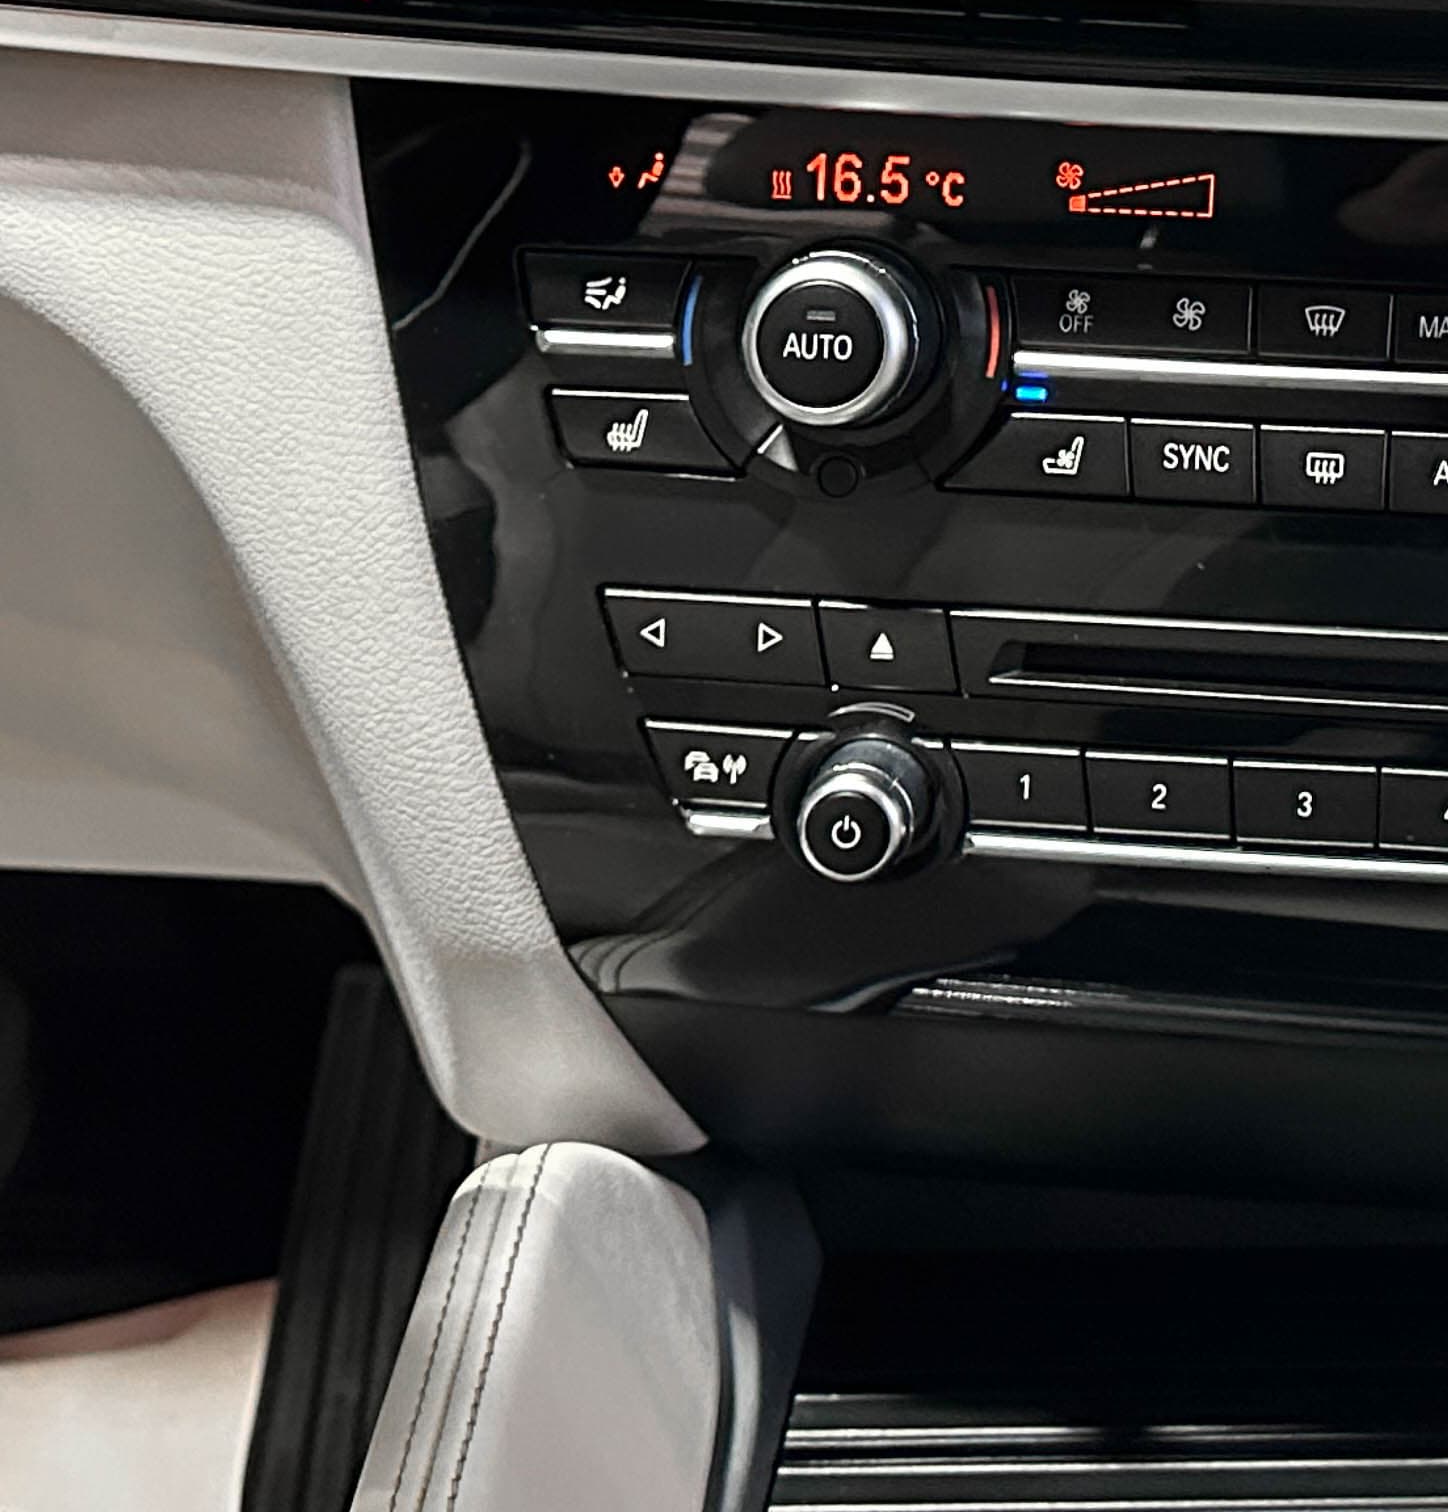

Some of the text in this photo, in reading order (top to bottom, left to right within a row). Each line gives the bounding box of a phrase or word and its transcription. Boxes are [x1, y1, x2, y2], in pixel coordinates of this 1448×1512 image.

[806, 152, 911, 204] 16.5
[1059, 315, 1093, 334] OFF
[782, 332, 853, 361] AUTO
[1163, 442, 1230, 473] SYNC
[1019, 774, 1030, 800] 1
[1151, 783, 1167, 810] 2
[1296, 791, 1313, 818] 3
